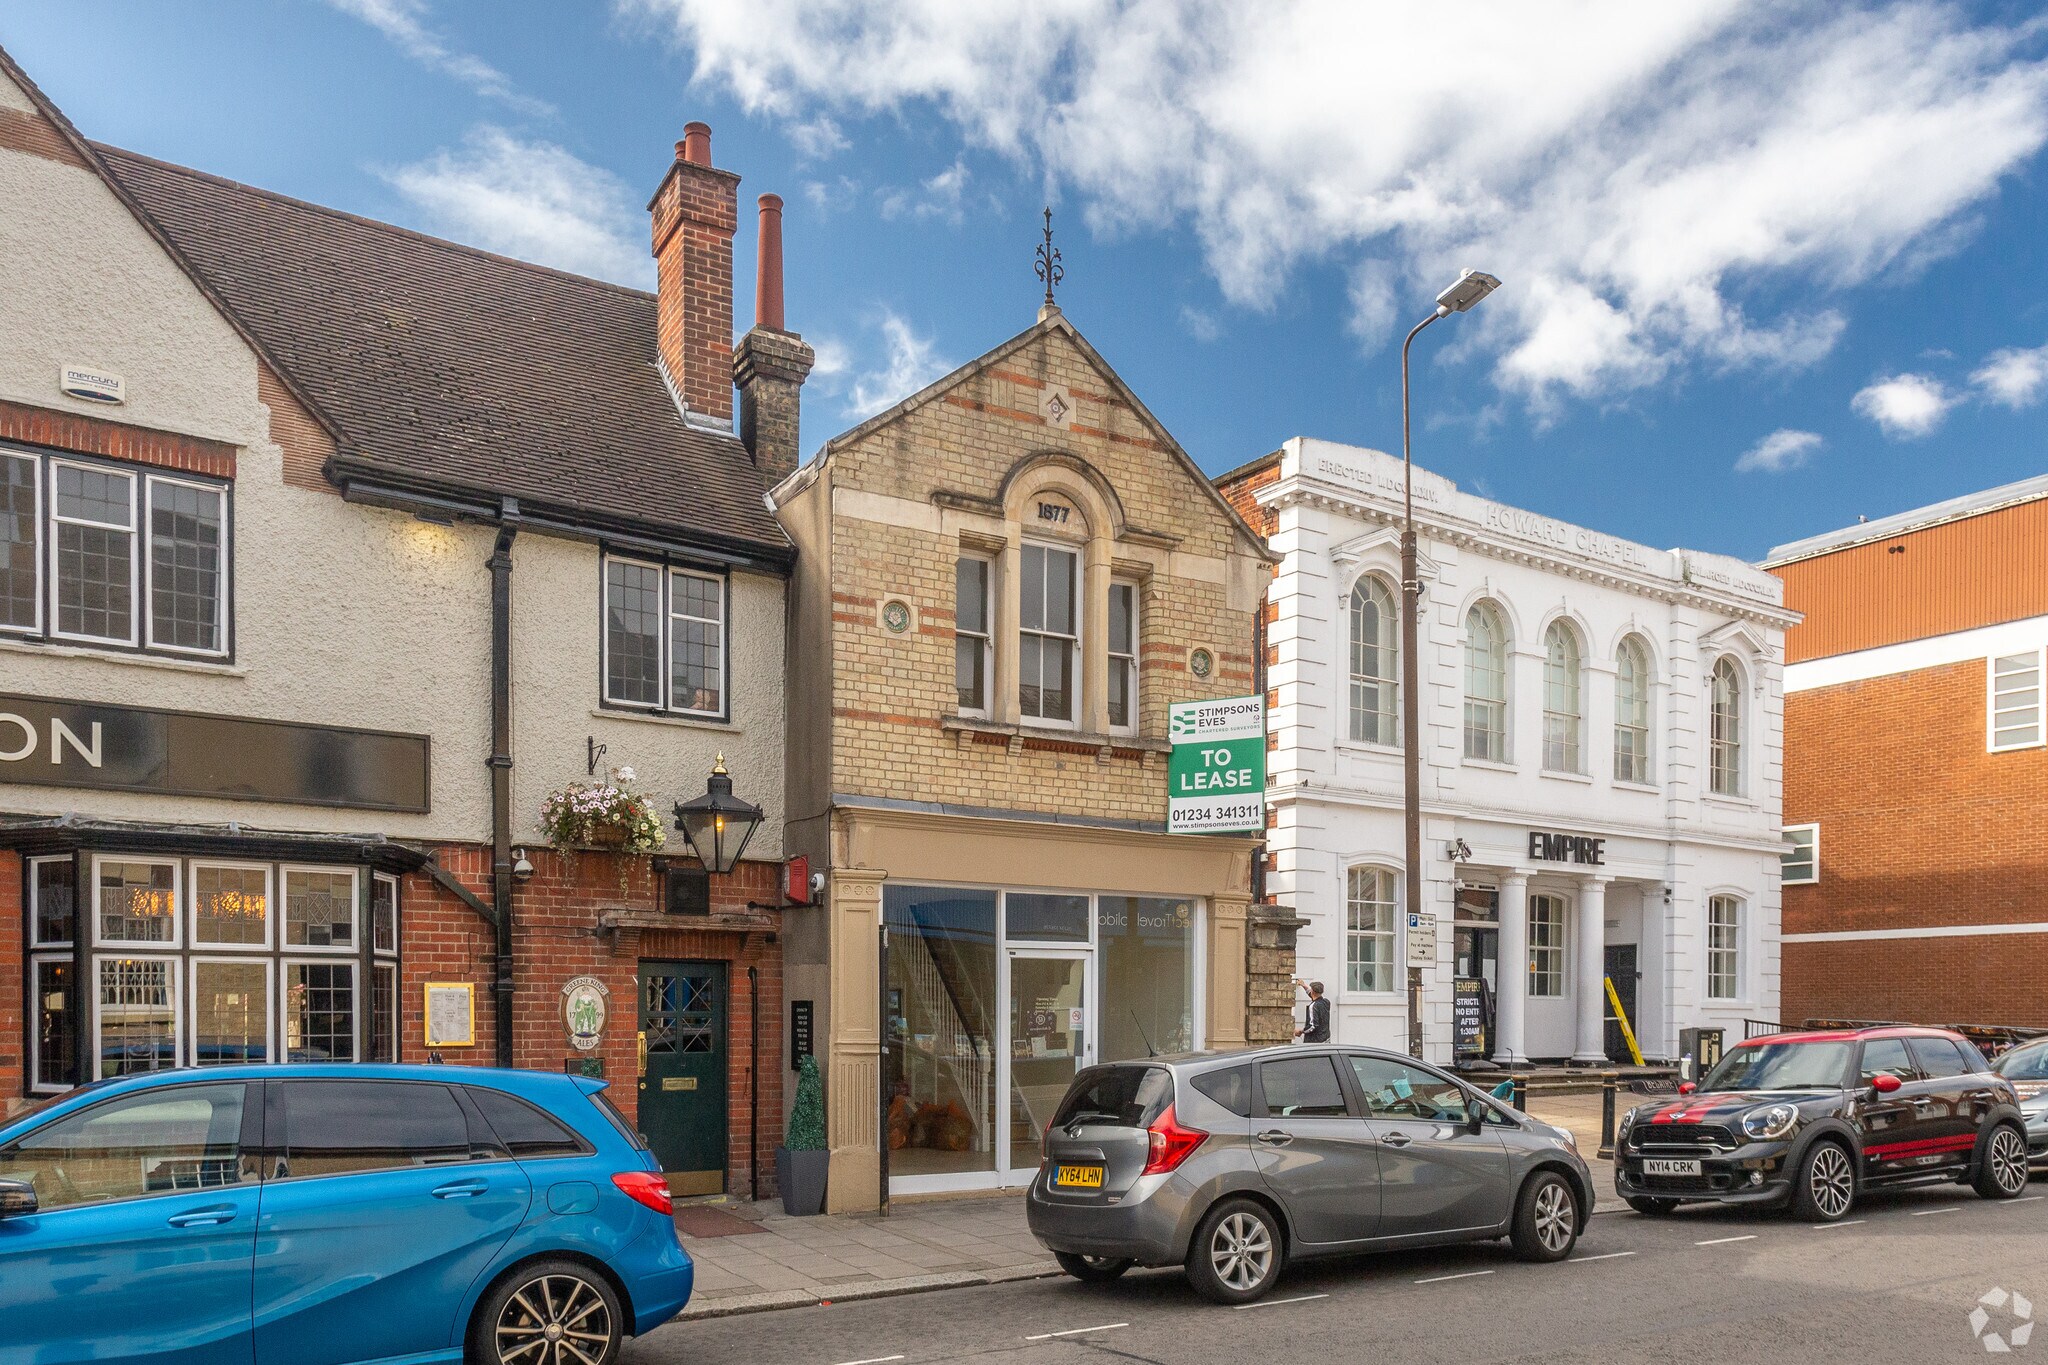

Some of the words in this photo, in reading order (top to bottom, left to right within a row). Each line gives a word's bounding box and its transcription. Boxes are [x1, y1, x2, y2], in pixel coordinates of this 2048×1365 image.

[68, 371, 119, 388] mercury
[1318, 458, 1372, 485] ERECTED
[1038, 502, 1071, 523] 1877
[1486, 504, 1566, 544] HOWARD
[1198, 703, 1260, 718] STIMPSONS
[1198, 717, 1226, 728] EVES
[1230, 724, 1261, 732] SURVEYORS
[0, 712, 102, 768] ON
[1200, 748, 1232, 767] TO
[1181, 768, 1252, 791] LEASE
[1172, 808, 1212, 822] 01234
[1216, 805, 1259, 819] 341311
[1172, 819, 1260, 829] www.stimpsonseves.co.uk
[1529, 831, 1606, 866] EMPIRE
[565, 978, 589, 993] GREENE
[590, 979, 606, 994] KING
[569, 1011, 576, 1019] 17
[595, 1011, 604, 1019] 99
[1455, 1008, 1465, 1016] NO
[1460, 1018, 1479, 1026] AFTER
[576, 1039, 594, 1047] ALES
[1649, 1160, 1671, 1172] NY14
[1672, 1161, 1694, 1173] CRK
[1058, 1168, 1081, 1182] KY64
[1082, 1168, 1101, 1183] LHN
